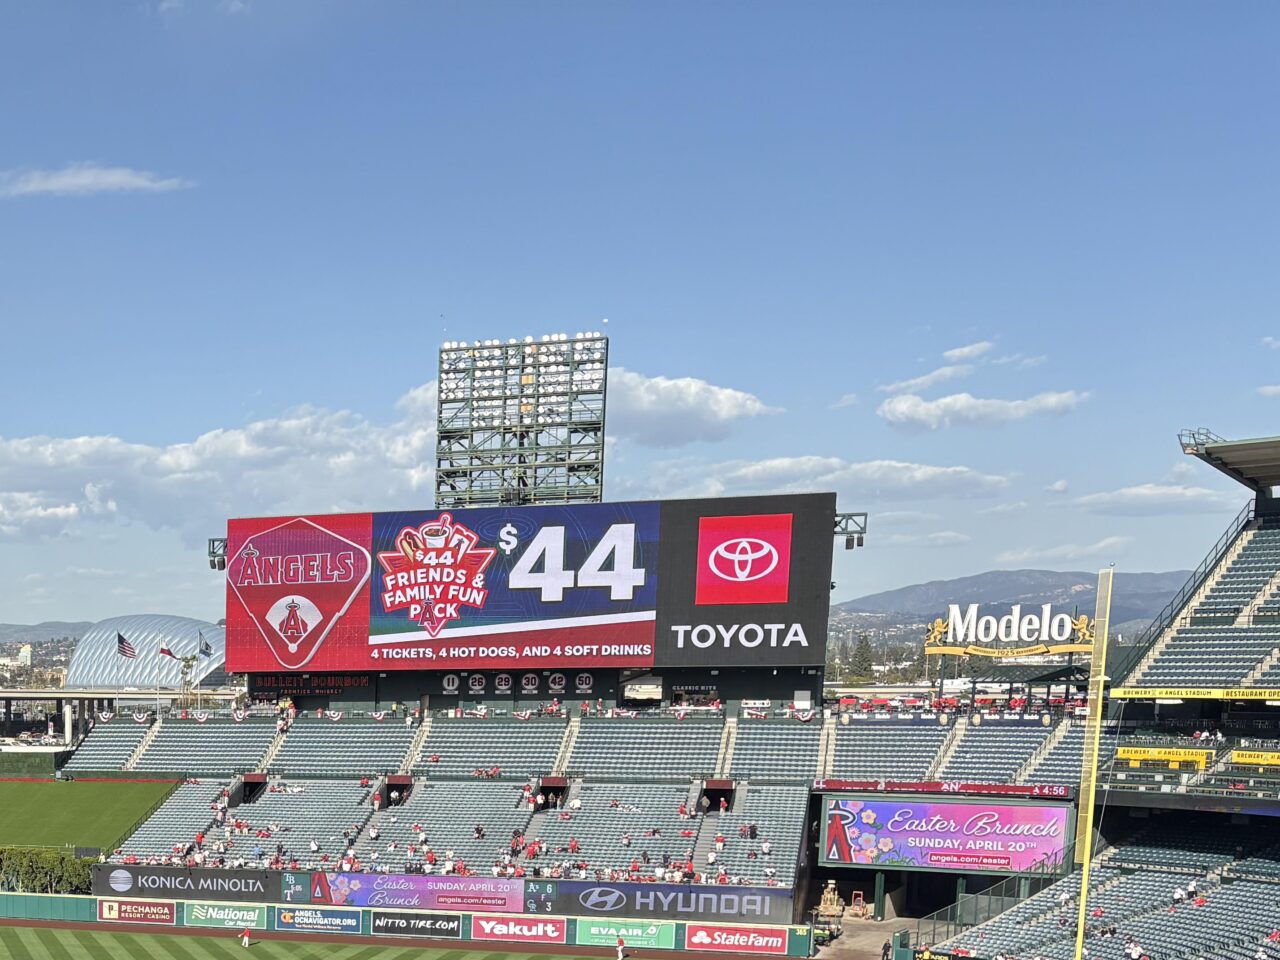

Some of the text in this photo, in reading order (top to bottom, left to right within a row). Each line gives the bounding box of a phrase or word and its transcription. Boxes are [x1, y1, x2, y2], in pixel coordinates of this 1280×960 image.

[415, 550, 455, 566] $44
[498, 523, 646, 602] $44
[237, 544, 354, 586] ANGELS
[385, 567, 485, 590] FRIENDS &
[384, 585, 484, 607] FAMILY FUN
[410, 602, 458, 626] PACK
[946, 603, 1072, 643] Modelo
[671, 623, 809, 648] TOYOTA
[371, 644, 651, 660] 4 TICKETS, 4 HOT DOGS, AND 4 SOFT DRINKS
[446, 677, 455, 687] 11
[471, 677, 483, 686] 26
[497, 677, 510, 686] 29
[524, 676, 536, 686] 30
[551, 676, 563, 686] 42
[578, 676, 591, 686] 50
[1042, 786, 1065, 795] 4:56
[888, 809, 1061, 837] Easter Brunch
[907, 837, 962, 851] SUNDAY,
[965, 839, 1005, 851] APRIL
[930, 854, 1010, 865] angels.com/easter
[138, 875, 264, 893] KONICA MINOLTA
[373, 875, 416, 890] Easter
[427, 882, 467, 892] SUNDAY,
[468, 883, 496, 892] APRIL
[546, 884, 552, 893] 6
[367, 892, 421, 906] Brunch
[438, 896, 506, 905] angels.com/easter
[635, 890, 769, 916] HYUNDAI
[121, 905, 169, 914] PECHANGA
[546, 902, 552, 911] 3
[207, 907, 259, 920] National
[294, 917, 356, 926] OCNAVIGATOR.ORG
[375, 916, 458, 930] NITTO TIRE.COM
[479, 920, 560, 937] Yakult
[590, 927, 643, 936] EVA AIR
[796, 928, 807, 936] 365
